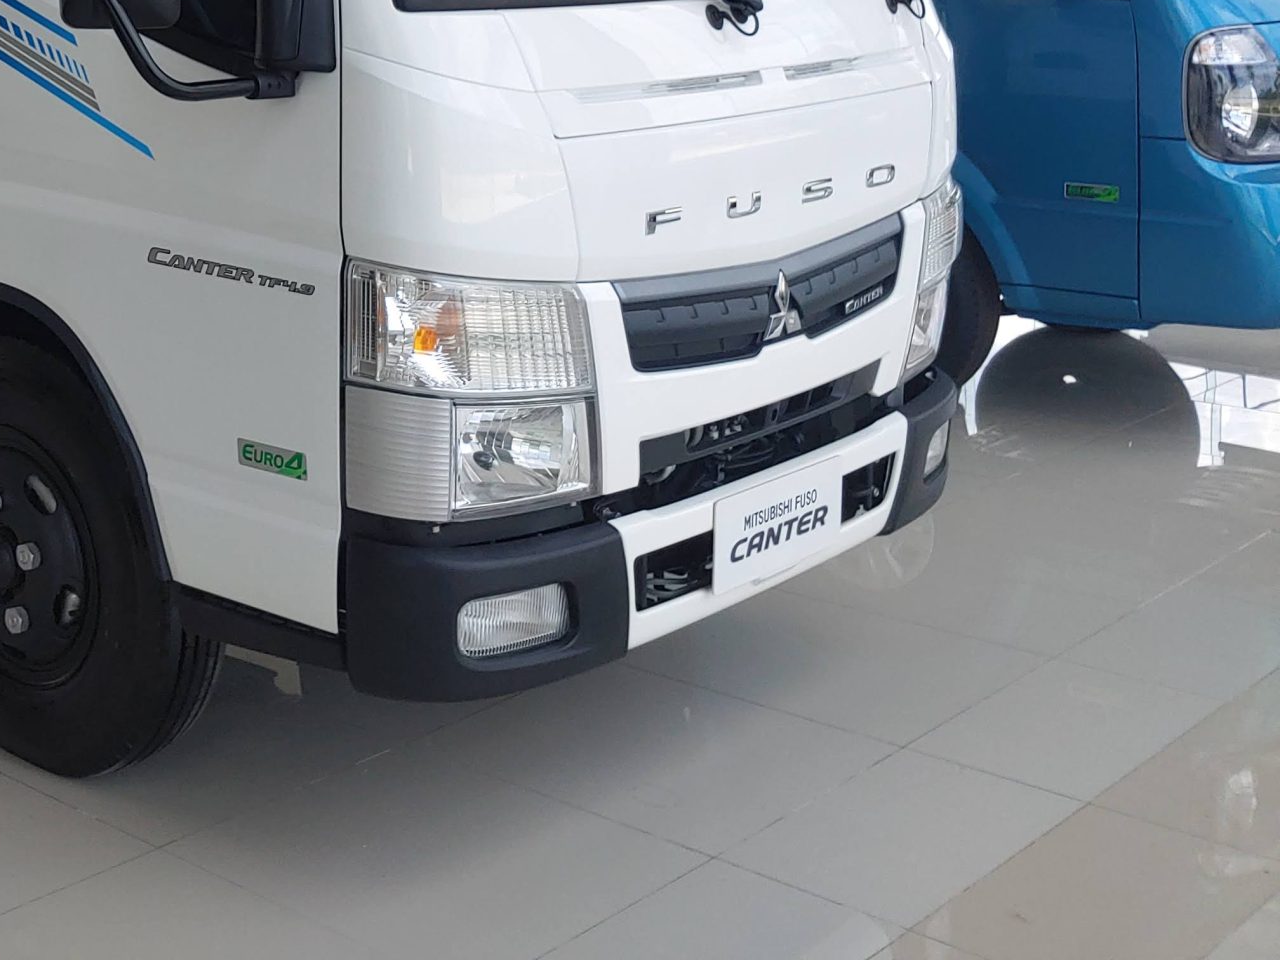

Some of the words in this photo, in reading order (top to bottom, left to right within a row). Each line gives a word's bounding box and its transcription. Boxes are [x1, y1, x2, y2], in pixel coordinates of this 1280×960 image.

[645, 163, 895, 236] FUSO
[147, 247, 255, 284] CANTER
[242, 443, 304, 471] EURO4
[744, 498, 793, 531] MITSUBISHI
[794, 488, 818, 511] FUSO
[730, 505, 829, 563] CANTER
